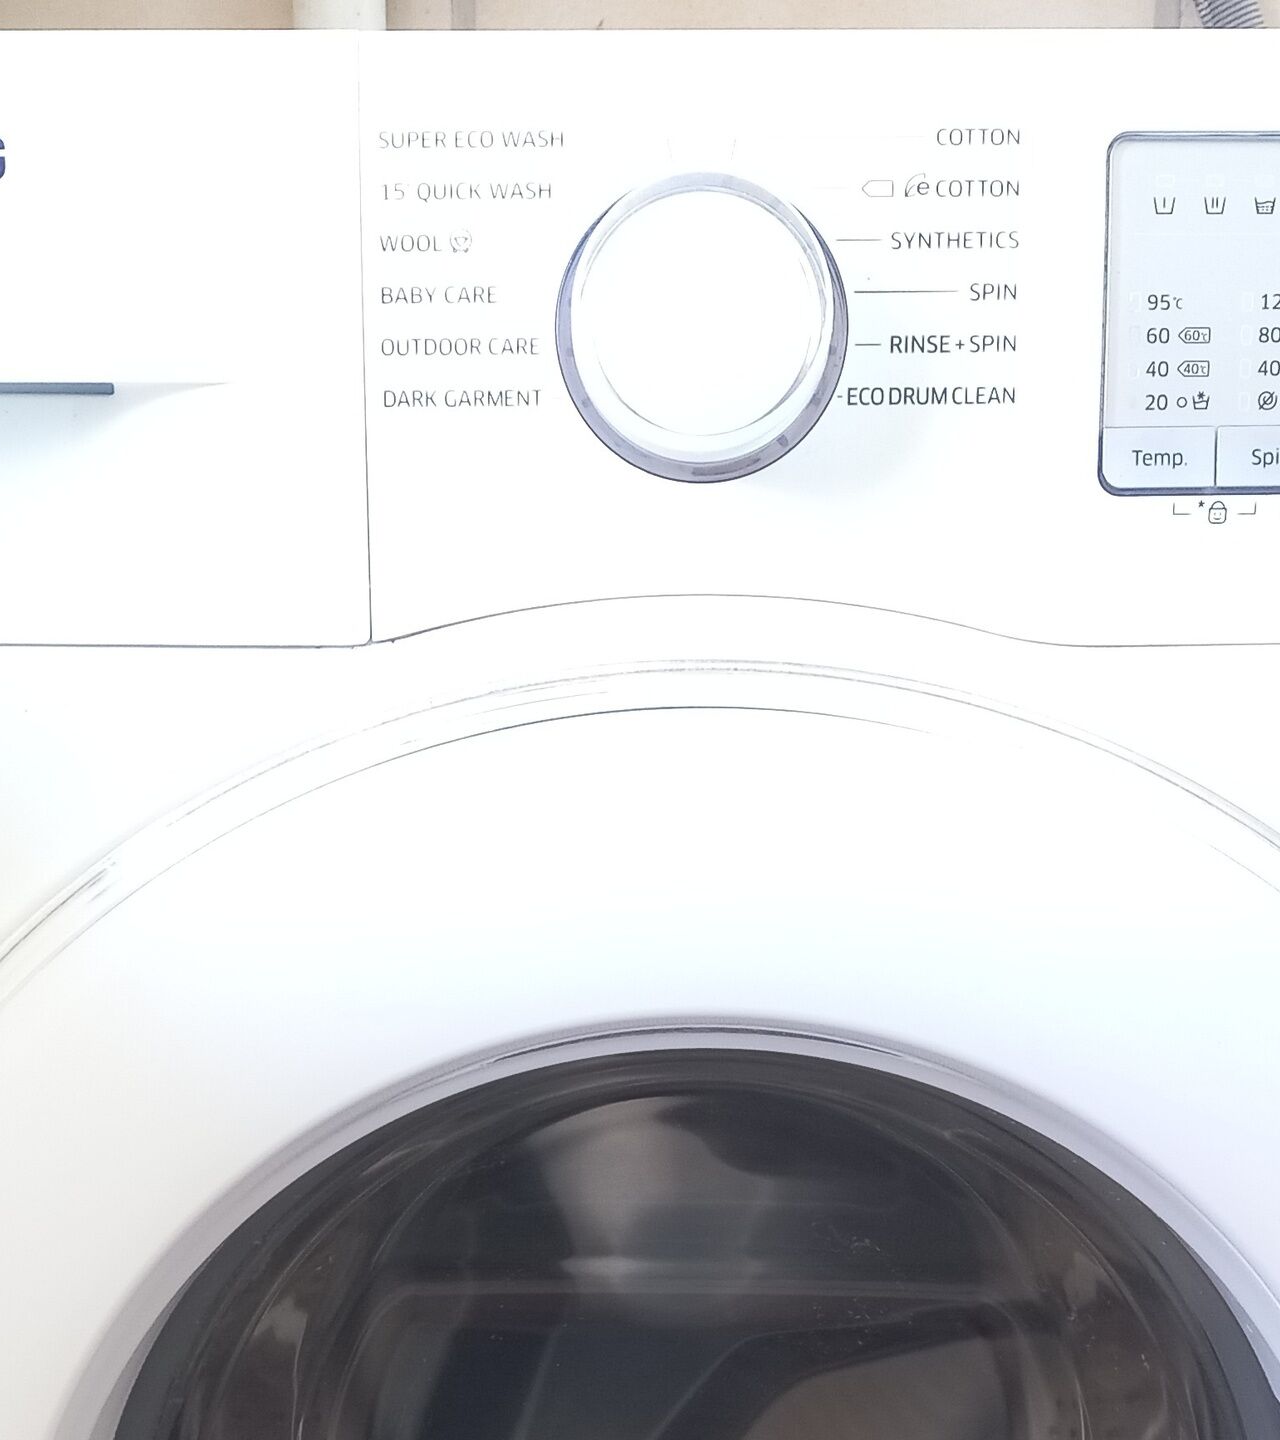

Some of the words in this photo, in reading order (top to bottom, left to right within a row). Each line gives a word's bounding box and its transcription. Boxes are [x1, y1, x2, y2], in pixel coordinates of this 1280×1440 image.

[379, 131, 447, 149] SUPER
[455, 131, 494, 148] ECO
[502, 130, 564, 148] WASH
[936, 128, 1020, 146] COTTON
[417, 182, 481, 203] QUICK
[490, 182, 552, 199] WASH
[936, 180, 1020, 197] COTTON
[379, 234, 442, 252] WOOL
[891, 231, 1019, 250] SYNTHETICS
[381, 286, 436, 304] BABY
[444, 286, 497, 303] CARE
[970, 283, 1017, 301] SPIN
[890, 335, 951, 353] RINSE
[970, 335, 1017, 353] SPIN
[1146, 327, 1170, 344] 60
[381, 338, 481, 356] OUTDOOR
[488, 338, 540, 355] CARE
[1145, 361, 1169, 378] 40
[383, 389, 437, 408] DARK
[444, 389, 541, 408] GARMENT
[847, 387, 884, 406] ECO
[889, 387, 947, 405] DRUM
[952, 386, 1016, 405] CLEAN
[1145, 394, 1168, 411] 20
[1132, 450, 1188, 469] Temp.
